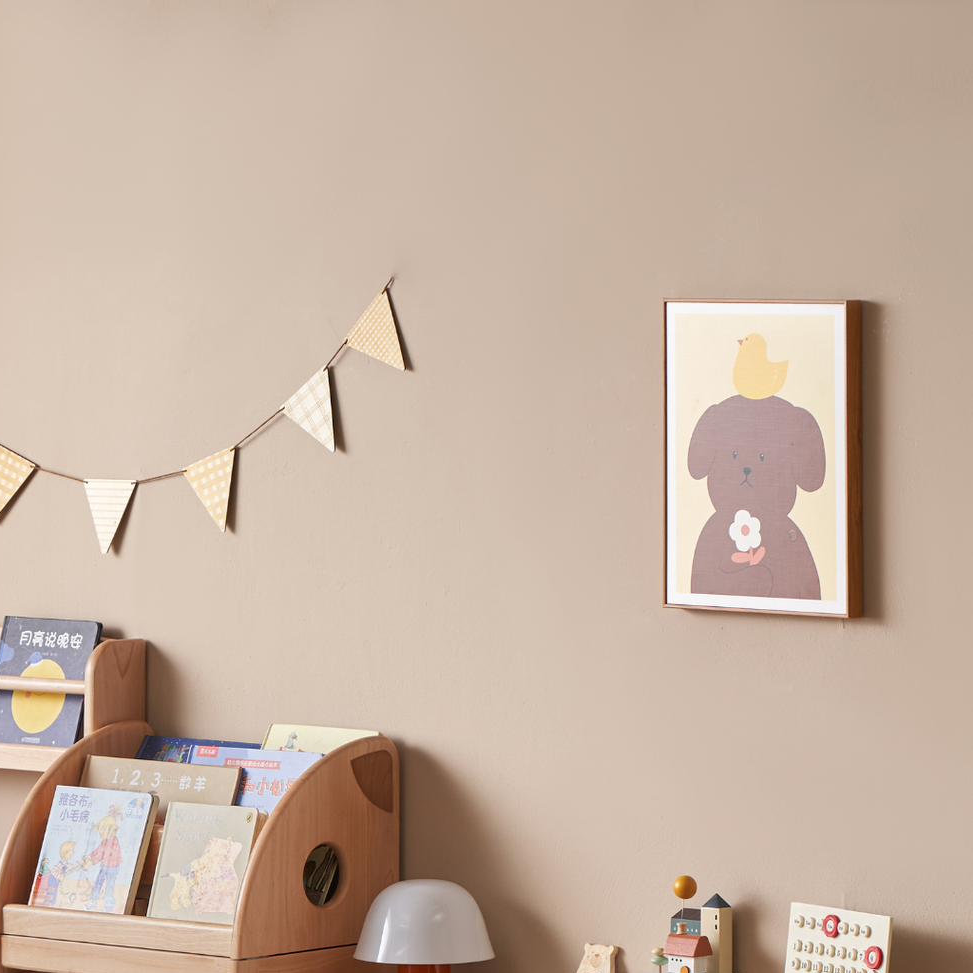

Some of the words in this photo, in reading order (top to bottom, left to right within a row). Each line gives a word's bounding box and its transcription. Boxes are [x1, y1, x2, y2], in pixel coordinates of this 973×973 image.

[19, 630, 83, 649] 月亮说晚安
[58, 792, 93, 808] 雅各布的
[59, 809, 90, 823] 小毛病
[175, 808, 221, 825] Where's
[175, 828, 209, 844] Spot?
[823, 965, 829, 973] 12
